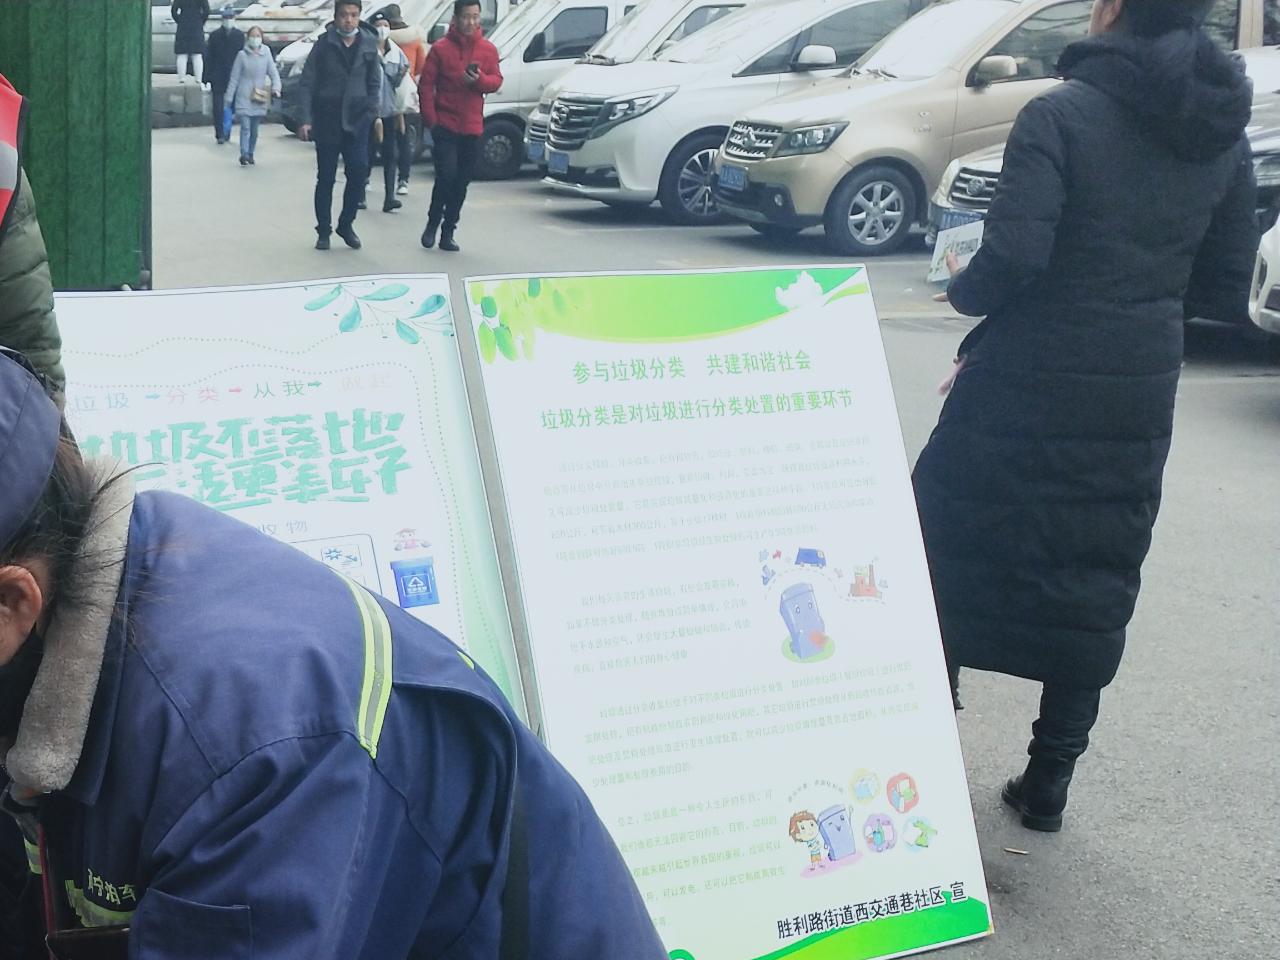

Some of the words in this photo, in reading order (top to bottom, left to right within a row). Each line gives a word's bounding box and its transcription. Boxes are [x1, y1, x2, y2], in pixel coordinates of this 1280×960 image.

[572, 355, 686, 385] 参与垃圾分类
[706, 349, 812, 376] 共建和谐社会
[253, 380, 305, 399] 从我
[540, 387, 854, 430] 垃圾分类是对垃圾进行分类处置的重要环节
[776, 886, 945, 939] 胜利路街道西交通巷社区
[949, 881, 967, 902] 宣
